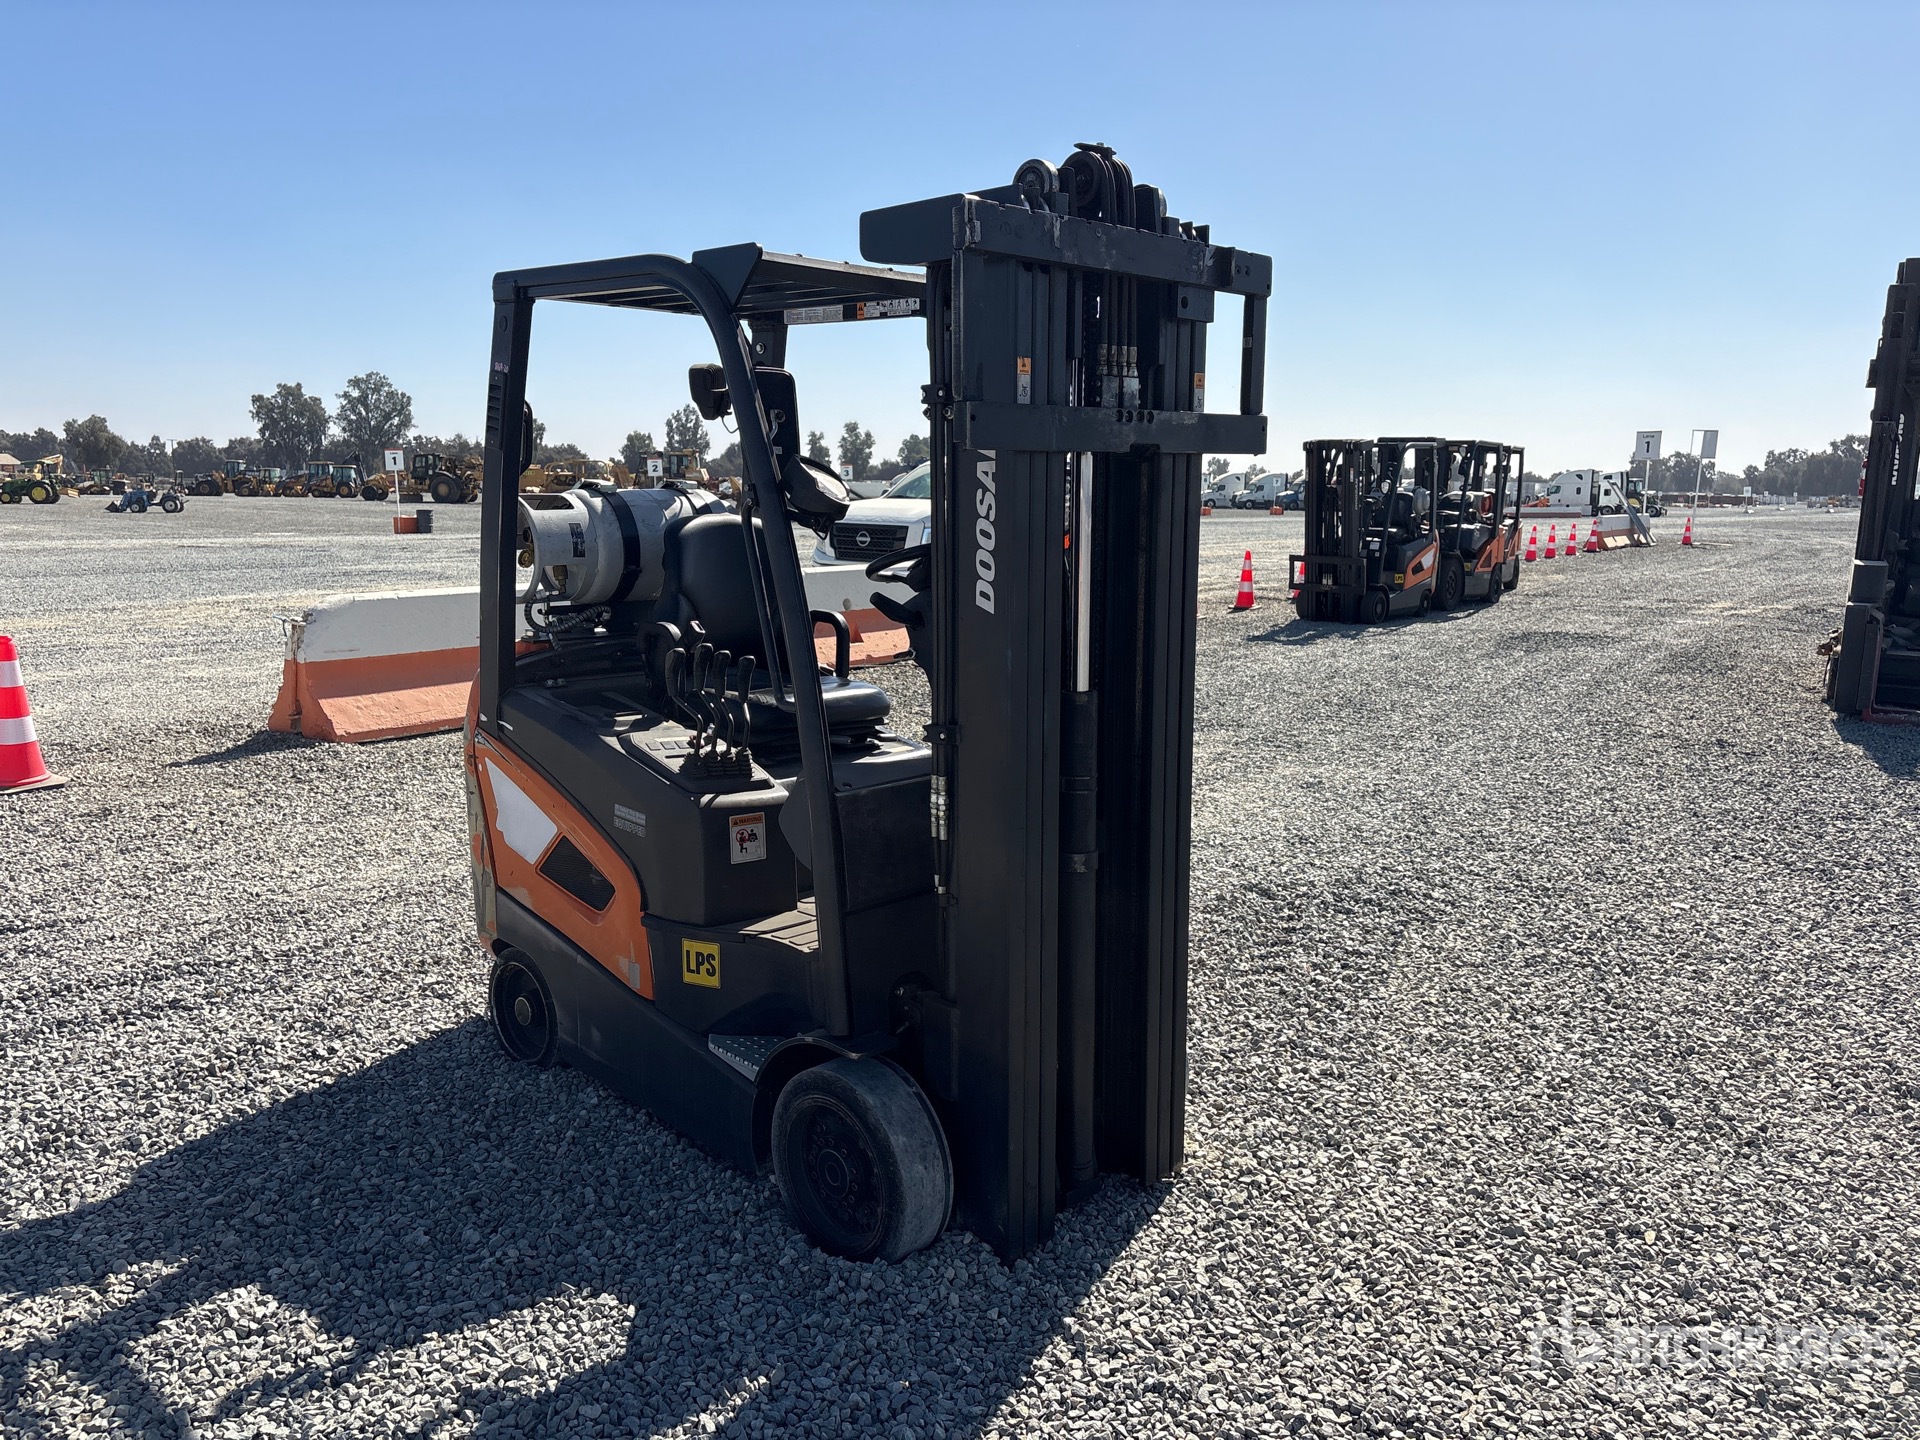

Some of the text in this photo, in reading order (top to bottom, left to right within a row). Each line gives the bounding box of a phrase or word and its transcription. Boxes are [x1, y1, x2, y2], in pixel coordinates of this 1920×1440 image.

[1645, 440, 1651, 453] 1
[392, 456, 397, 466] 1
[652, 465, 659, 473] 2
[739, 815, 762, 825] WARNING
[614, 816, 646, 838] EQUIPPED
[685, 949, 717, 977] LPS
